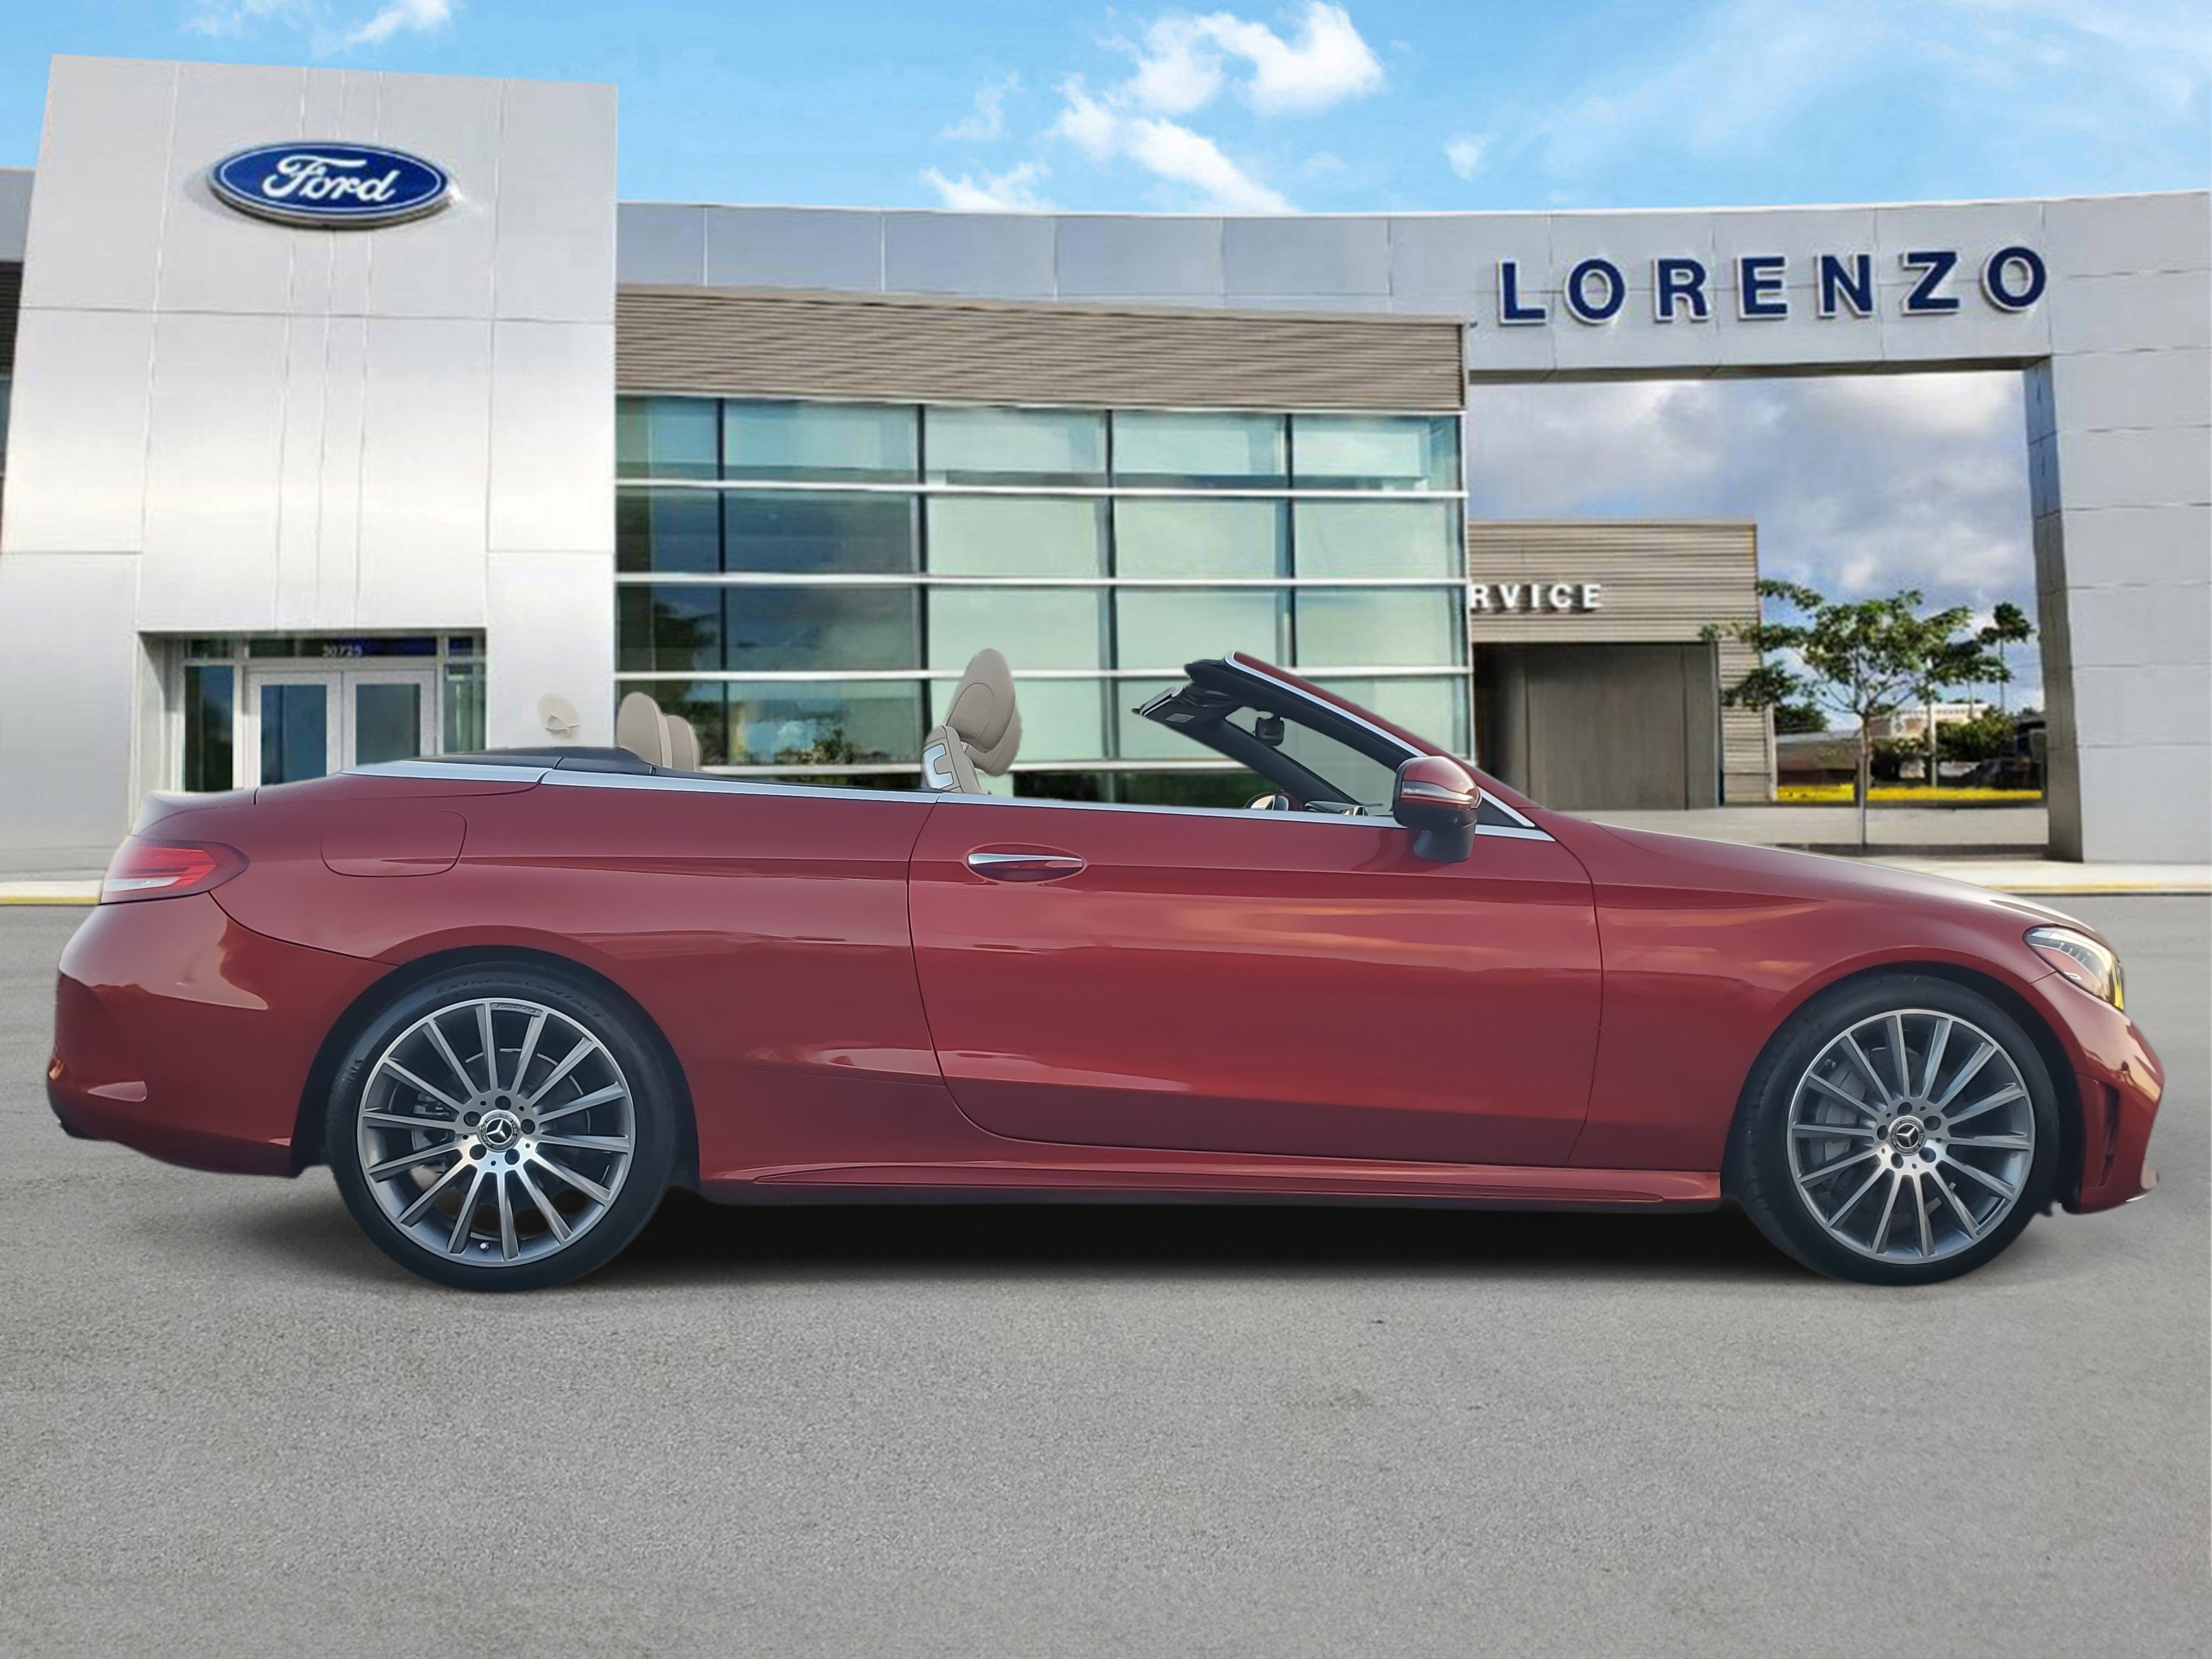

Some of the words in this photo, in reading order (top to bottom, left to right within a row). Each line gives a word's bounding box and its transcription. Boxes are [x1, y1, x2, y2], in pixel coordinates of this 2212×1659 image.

[262, 154, 401, 202] Ford
[1497, 245, 2047, 325] LORENZO
[1470, 583, 1601, 609] RVICE
